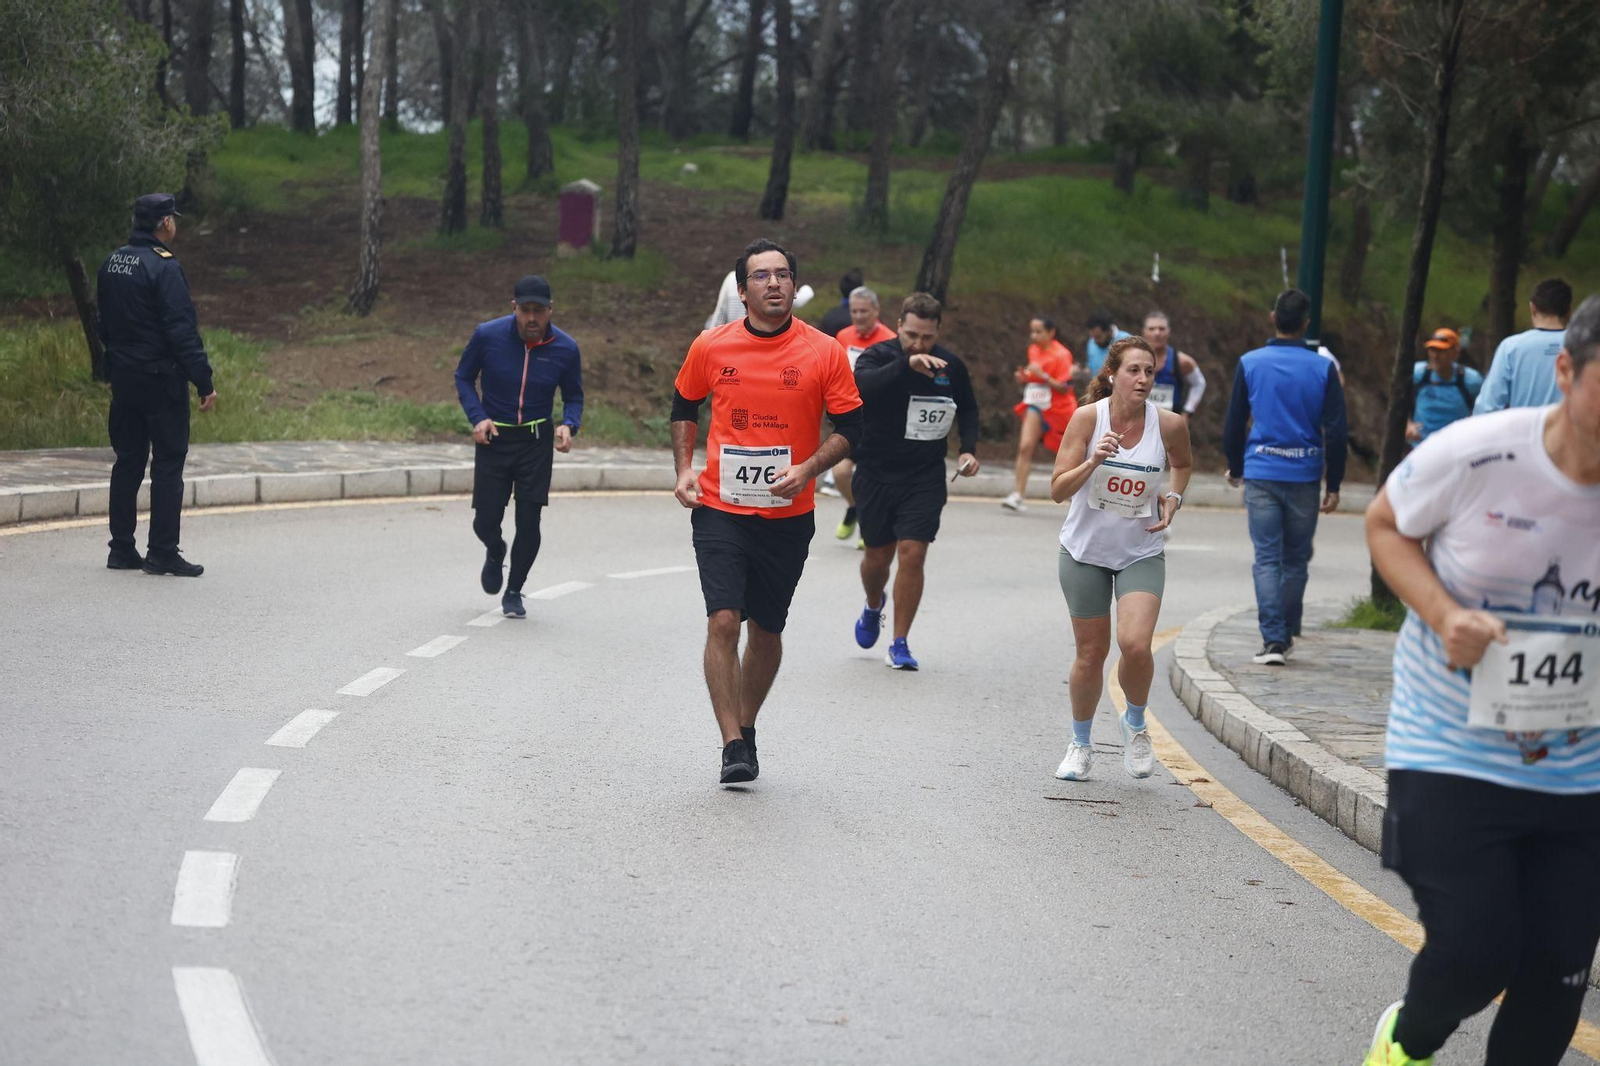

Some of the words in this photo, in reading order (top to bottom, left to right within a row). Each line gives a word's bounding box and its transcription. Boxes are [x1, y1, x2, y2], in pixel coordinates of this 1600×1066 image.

[109, 254, 140, 266] POLICIA
[107, 264, 133, 275] LOCAL
[752, 413, 778, 421] Ciudad
[918, 409, 946, 423] 367
[763, 421, 789, 430] Málaga
[736, 465, 777, 485] 476
[1107, 476, 1146, 498] 609
[1507, 650, 1584, 688] 144
